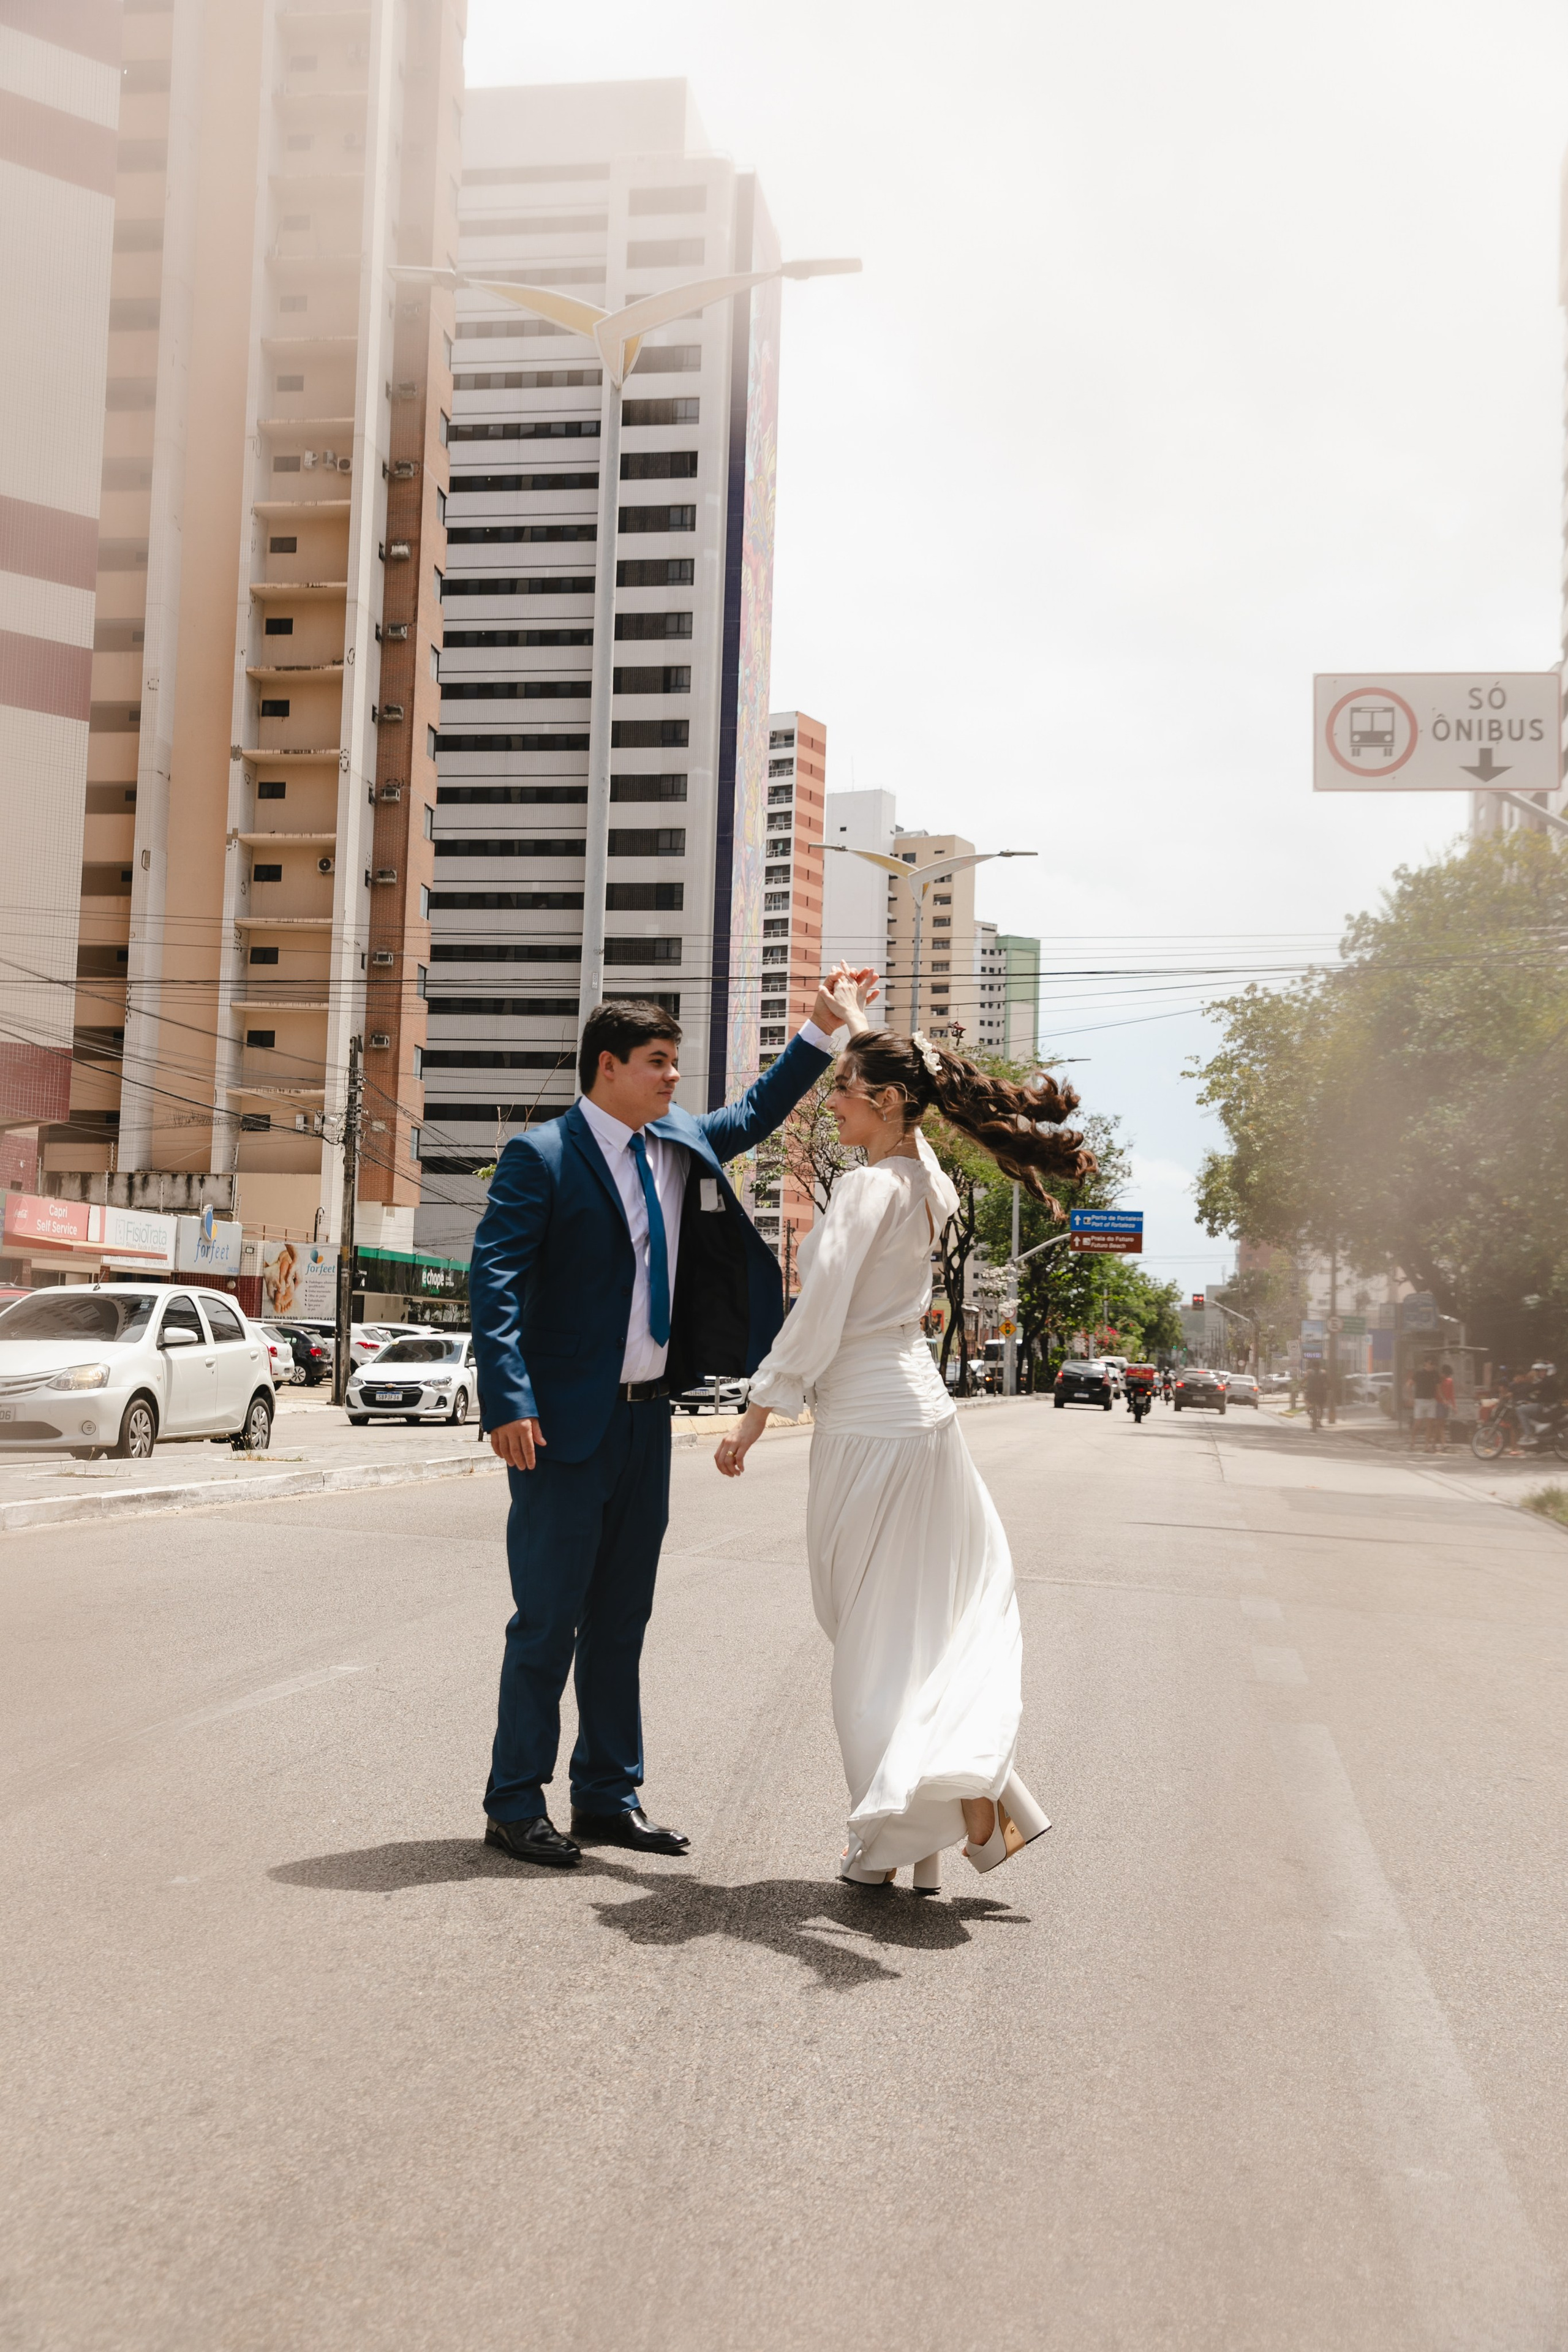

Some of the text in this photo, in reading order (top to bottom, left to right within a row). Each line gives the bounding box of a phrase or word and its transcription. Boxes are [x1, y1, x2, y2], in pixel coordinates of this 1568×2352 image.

[1468, 681, 1507, 710] SÓ
[1432, 714, 1544, 742] ÔNIBUS
[49, 1204, 68, 1219] Capri
[36, 1219, 77, 1235] Self Service
[126, 1221, 167, 1245] FisioTrata
[194, 1237, 229, 1264] forfeet
[305, 1262, 336, 1275] forfeet
